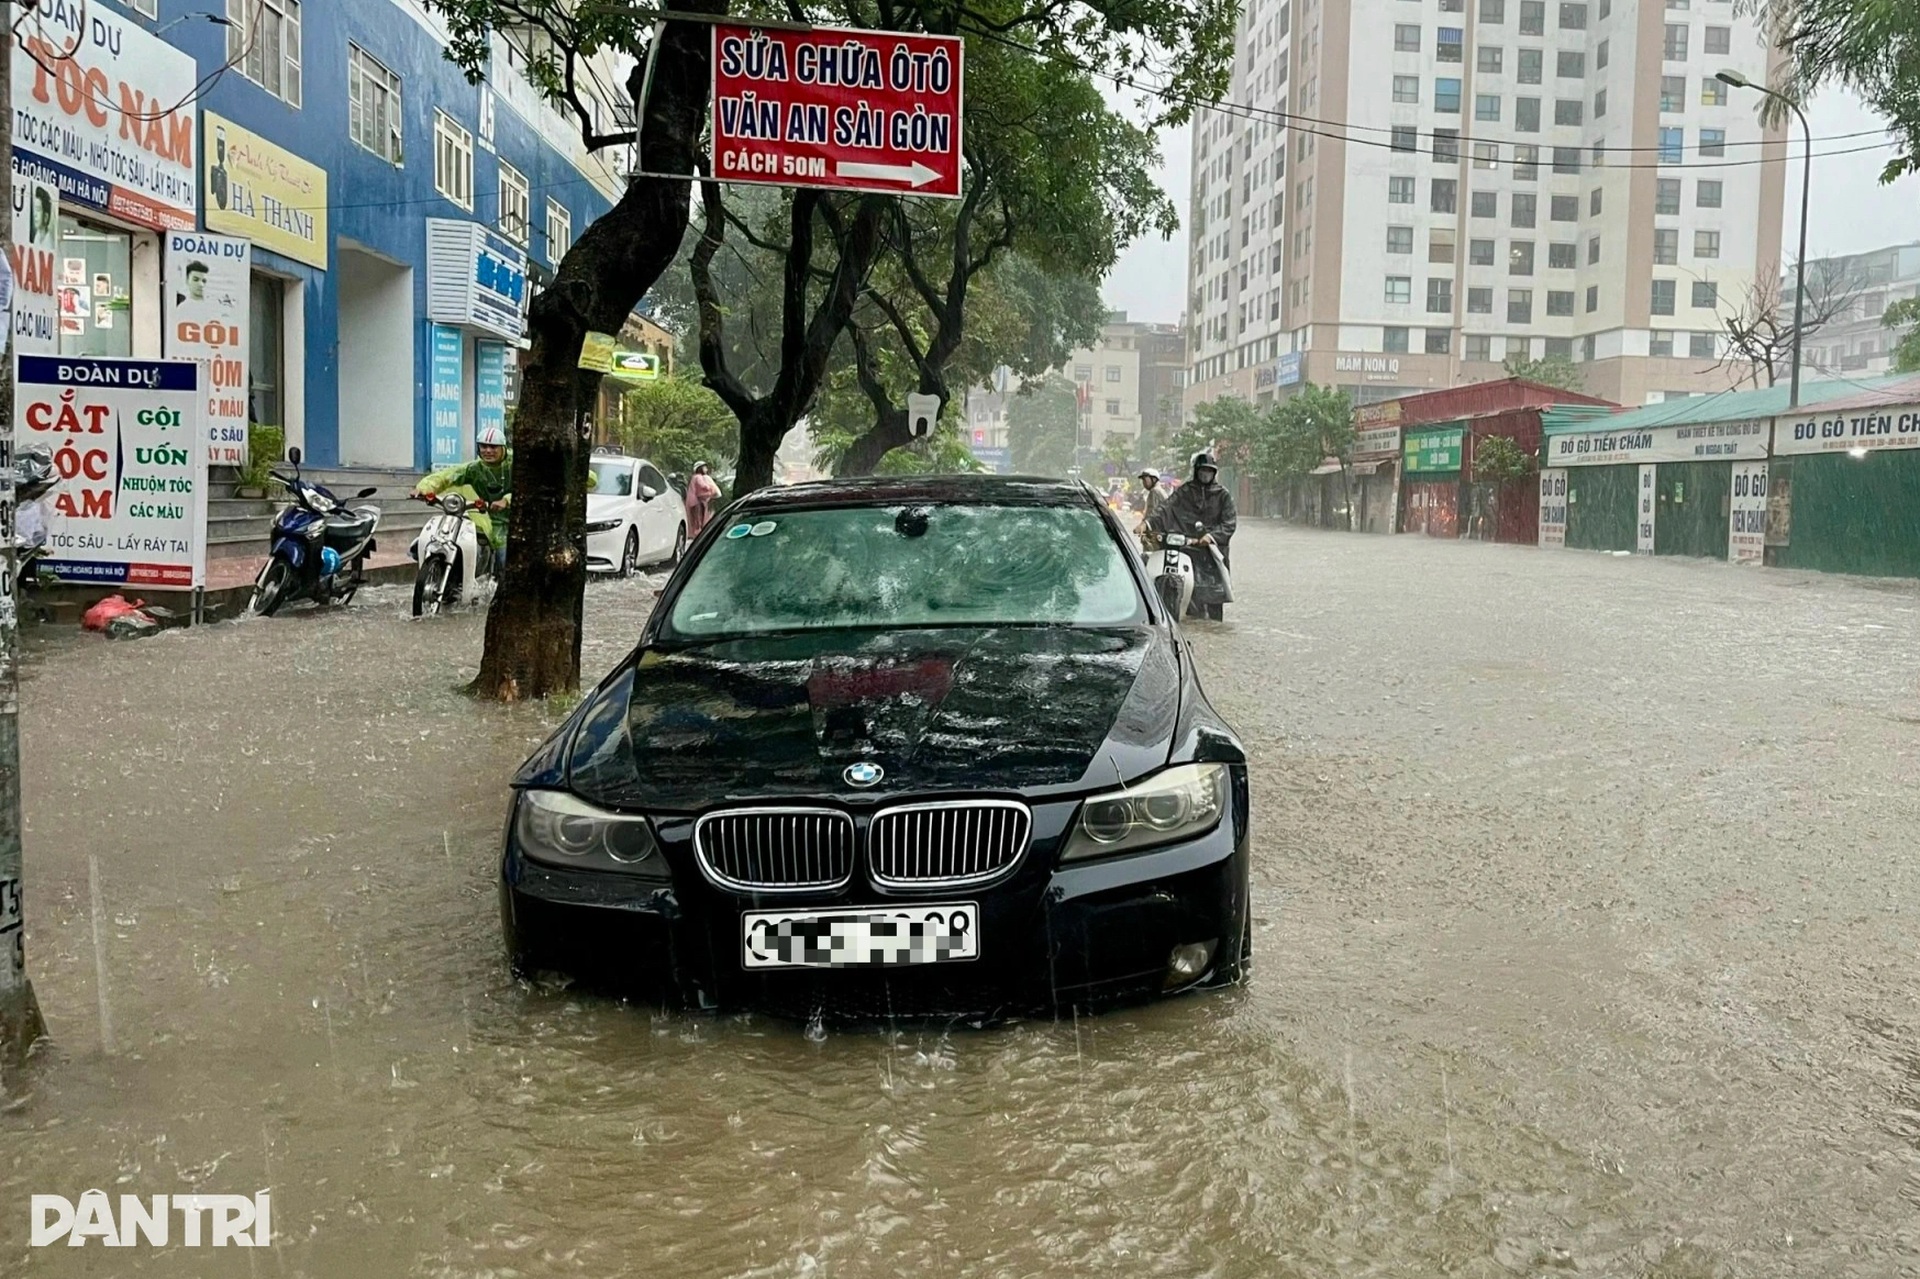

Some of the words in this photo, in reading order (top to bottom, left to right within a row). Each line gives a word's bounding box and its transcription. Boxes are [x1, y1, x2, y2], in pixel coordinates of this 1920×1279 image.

[93, 17, 122, 60] DỰ
[722, 27, 788, 81] SỬA
[796, 40, 884, 89] CHỮA
[890, 43, 950, 94] ÔTÔ
[118, 81, 192, 169] NAM
[719, 91, 780, 141] VĂN
[786, 102, 828, 144] AN
[834, 101, 884, 148] SÀI
[890, 103, 950, 153] GÒN
[17, 108, 38, 142] TÓC
[40, 115, 61, 152] CÁC
[63, 127, 83, 162] MÀU
[110, 147, 128, 179] TÓC
[723, 148, 778, 174] CÁCH
[783, 156, 826, 177] 50M
[20, 158, 57, 188] HOÀNG
[58, 174, 76, 196] MAI
[77, 180, 92, 200] HÀ
[13, 184, 26, 217] Ự
[232, 181, 255, 218] HÀ
[261, 194, 314, 241] THANH
[172, 236, 218, 256] ĐOÀN
[224, 242, 246, 262] DỰ
[16, 306, 34, 338] CÁC
[176, 320, 239, 349] GỘI
[58, 365, 120, 383] ĐOÀN
[1364, 358, 1386, 372] NON
[1389, 360, 1399, 374] IQ
[26, 388, 110, 434] CẮT
[137, 406, 180, 430] GỘI
[220, 397, 244, 418] MÀU
[222, 426, 244, 442] SÂU
[1898, 413, 1920, 433] CH
[54, 438, 108, 480] ÓC
[136, 442, 188, 466] UỐN
[122, 476, 166, 495] NHUỘM
[170, 477, 192, 493] TÓC
[55, 489, 112, 519] AM
[130, 504, 154, 518] CÁC
[157, 504, 184, 519] MÀU
[52, 534, 74, 547] TÓC
[79, 534, 104, 549] SÂU
[118, 533, 140, 550] LẤY
[144, 537, 167, 552] RÁY
[170, 540, 188, 553] TAI
